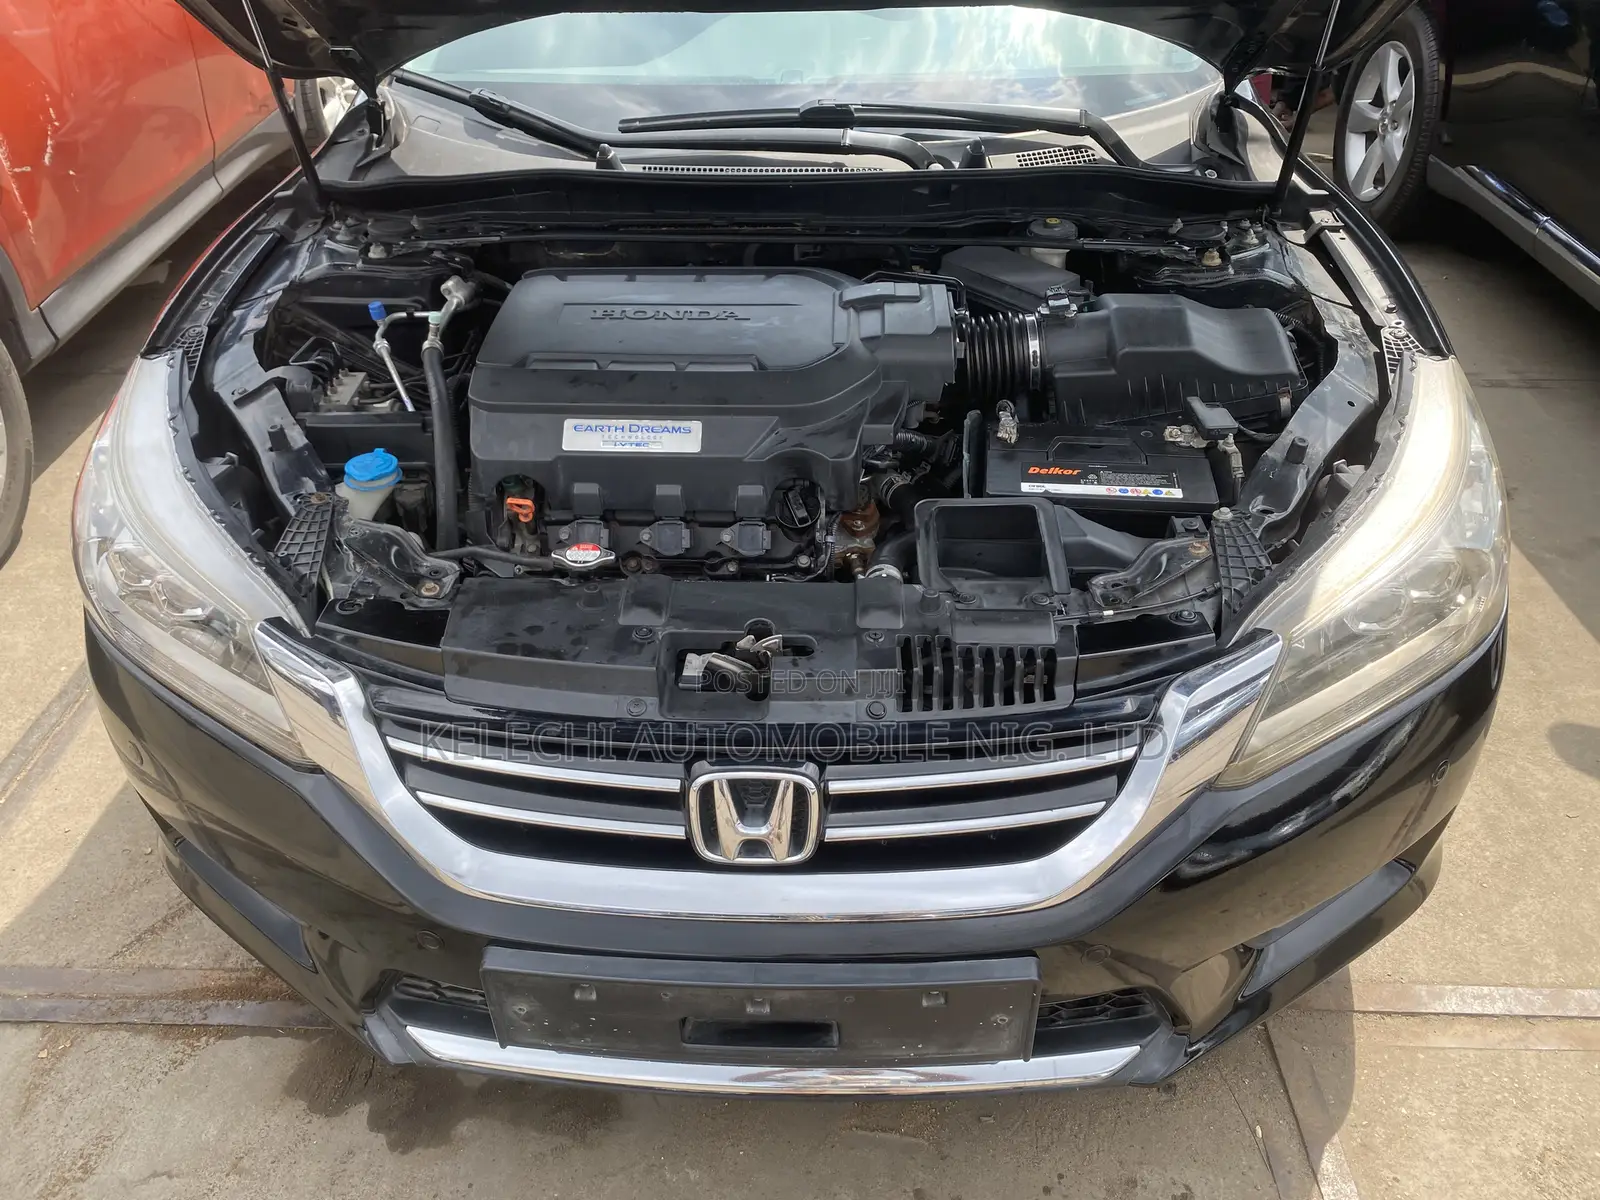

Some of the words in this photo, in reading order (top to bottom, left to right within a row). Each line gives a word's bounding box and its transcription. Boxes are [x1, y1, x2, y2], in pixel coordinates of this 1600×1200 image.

[590, 308, 751, 321] HONDA
[573, 423, 625, 433] EARTH
[628, 423, 692, 434] DREAMS
[1028, 466, 1082, 476] Delkor
